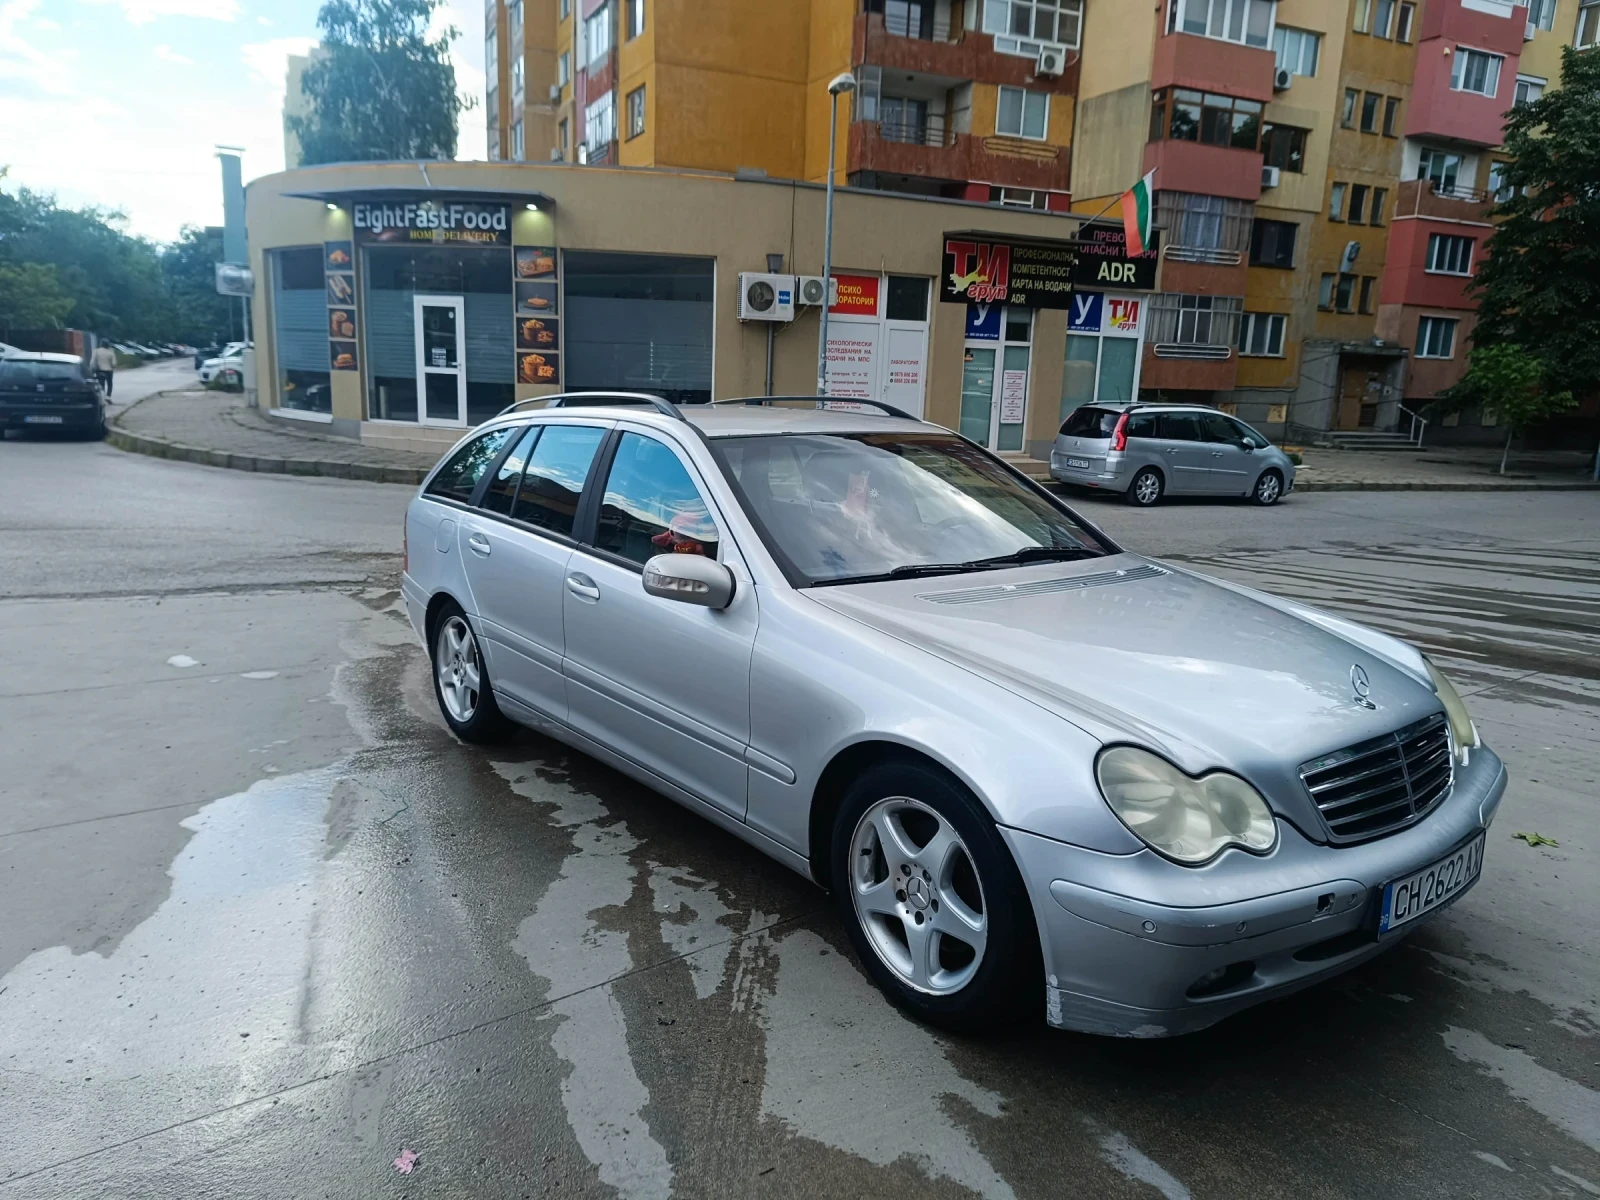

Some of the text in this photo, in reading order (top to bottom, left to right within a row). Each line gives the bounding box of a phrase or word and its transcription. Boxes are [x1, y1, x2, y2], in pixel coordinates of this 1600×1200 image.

[354, 204, 507, 233] EightFastFood
[410, 230, 499, 242] HOME DELIVERY
[1094, 230, 1126, 243] ПРЕВО
[1013, 248, 1074, 261] ПРОФЕСИОНАЛНА
[1080, 245, 1157, 259] ОПАСНИ ТАРИ
[946, 240, 1010, 287] ТИ
[1012, 263, 1071, 277] КОМПЕТЕНТНОСТ
[1097, 261, 1136, 283] ADR
[838, 285, 862, 295] ПСИХО
[1011, 278, 1072, 293] КАРТА НА ВОДАЧИ
[967, 284, 1007, 302] груп
[1011, 294, 1026, 304] ADR
[837, 295, 875, 306] ОРАТОРИЯ
[1108, 299, 1139, 332] ТИ груп
[826, 339, 872, 347] СИХОЛОГИЧЕСКИ
[826, 347, 862, 355] ЗСЛЕДВАНИЯ
[1394, 876, 1423, 920] CH
[1423, 853, 1464, 908] 2622
